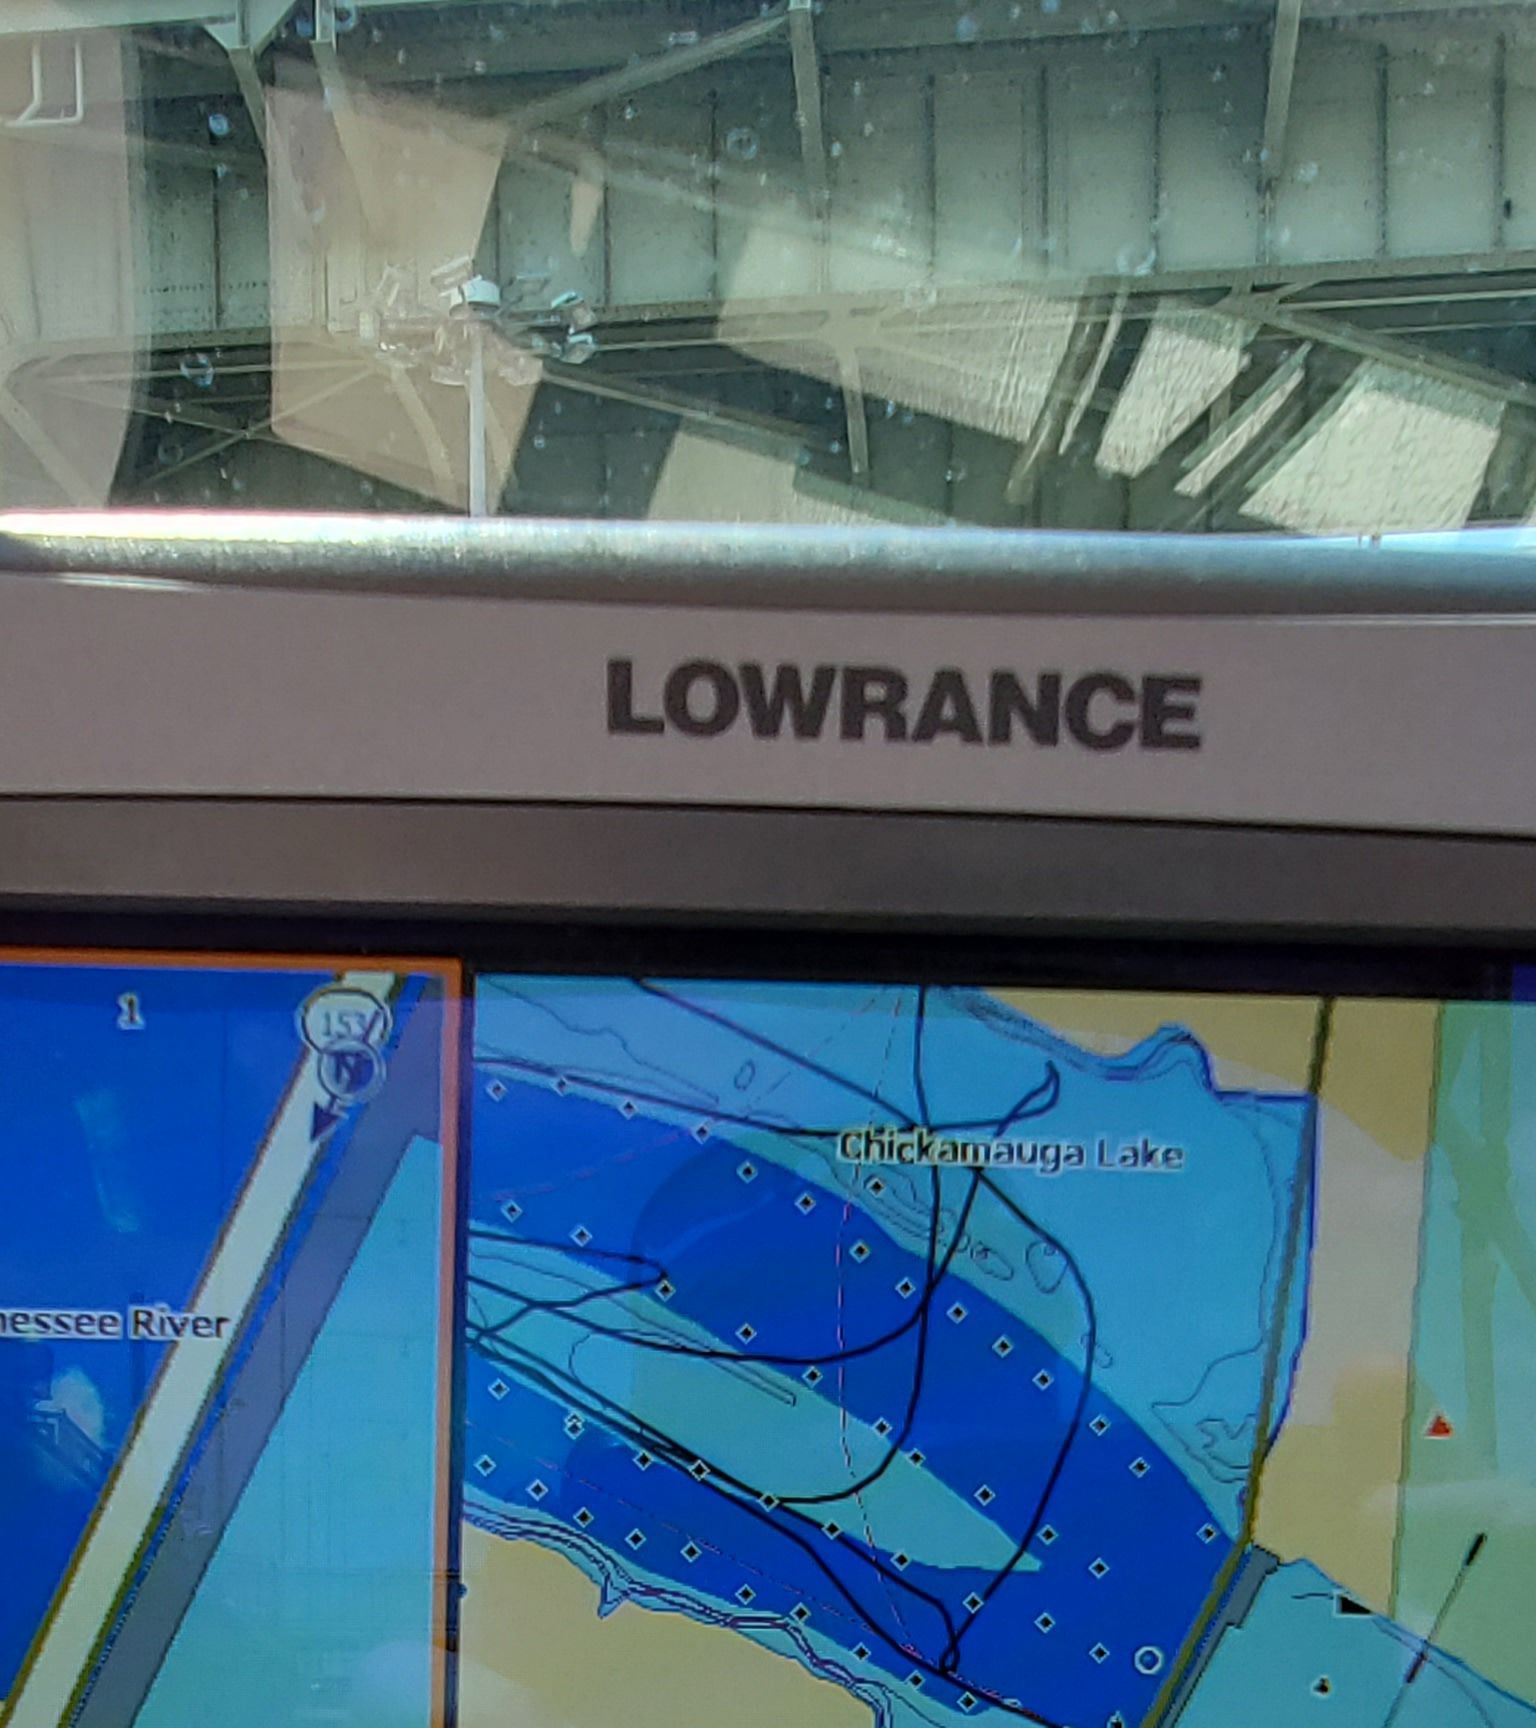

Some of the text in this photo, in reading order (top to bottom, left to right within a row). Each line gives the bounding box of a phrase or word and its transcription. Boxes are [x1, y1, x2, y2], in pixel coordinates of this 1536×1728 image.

[606, 657, 1202, 752] LOWRANCE
[839, 1128, 1184, 1172] Chickamauga Lake
[132, 1306, 229, 1339] River
